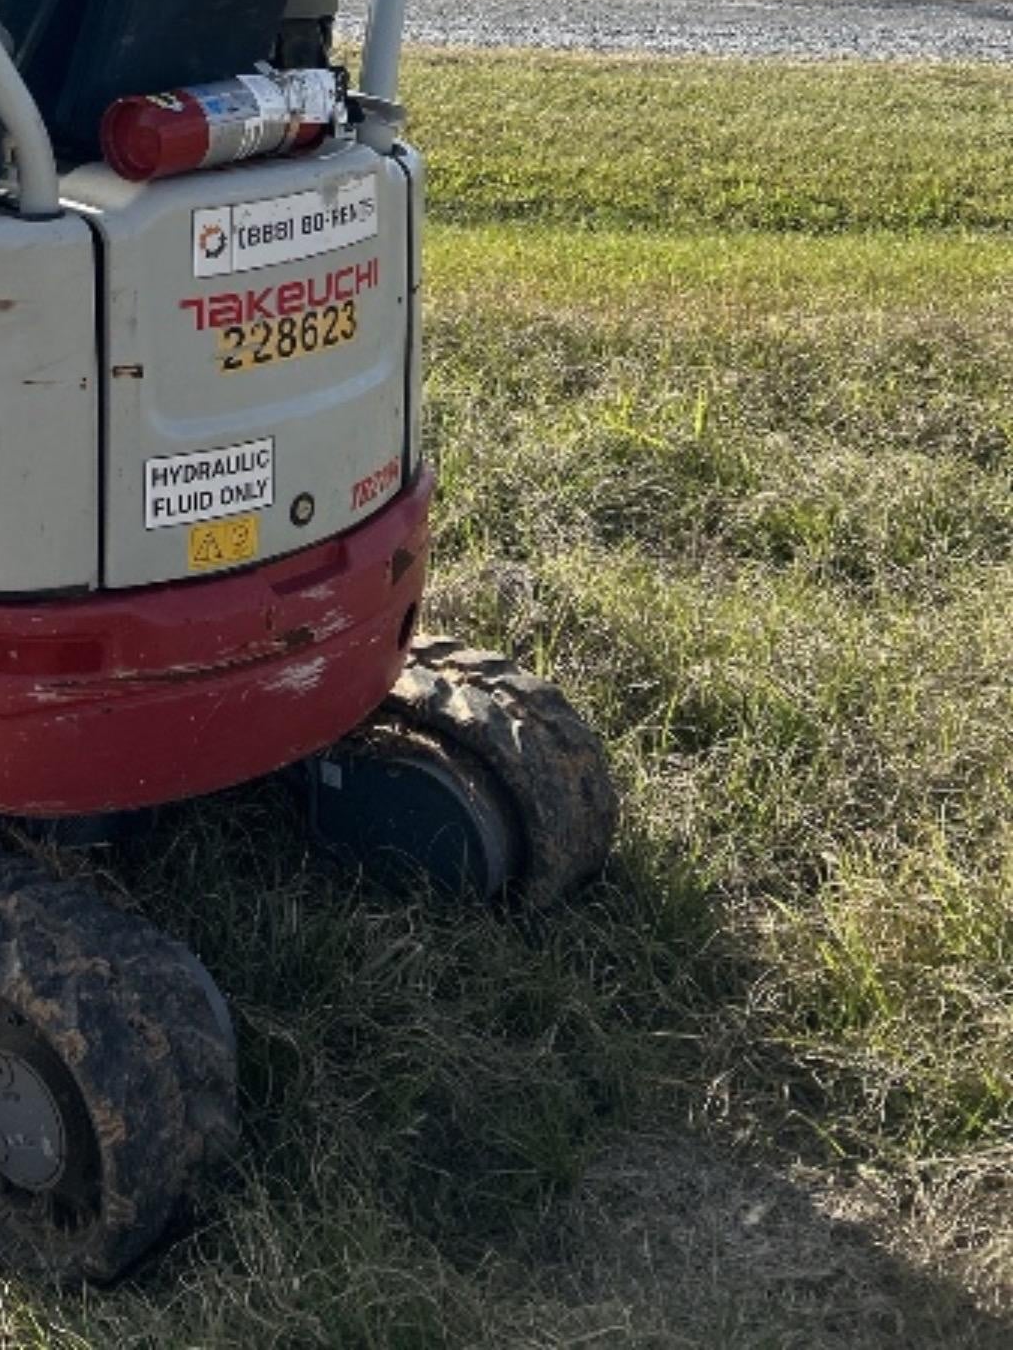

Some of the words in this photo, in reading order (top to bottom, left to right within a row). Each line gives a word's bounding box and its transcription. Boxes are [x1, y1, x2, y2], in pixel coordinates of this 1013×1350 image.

[178, 258, 379, 331] TAKEUCHI
[222, 300, 359, 370] 228623
[151, 449, 271, 488] HYDRAULIC
[153, 490, 213, 517] FLUID
[220, 477, 270, 505] ONLY
